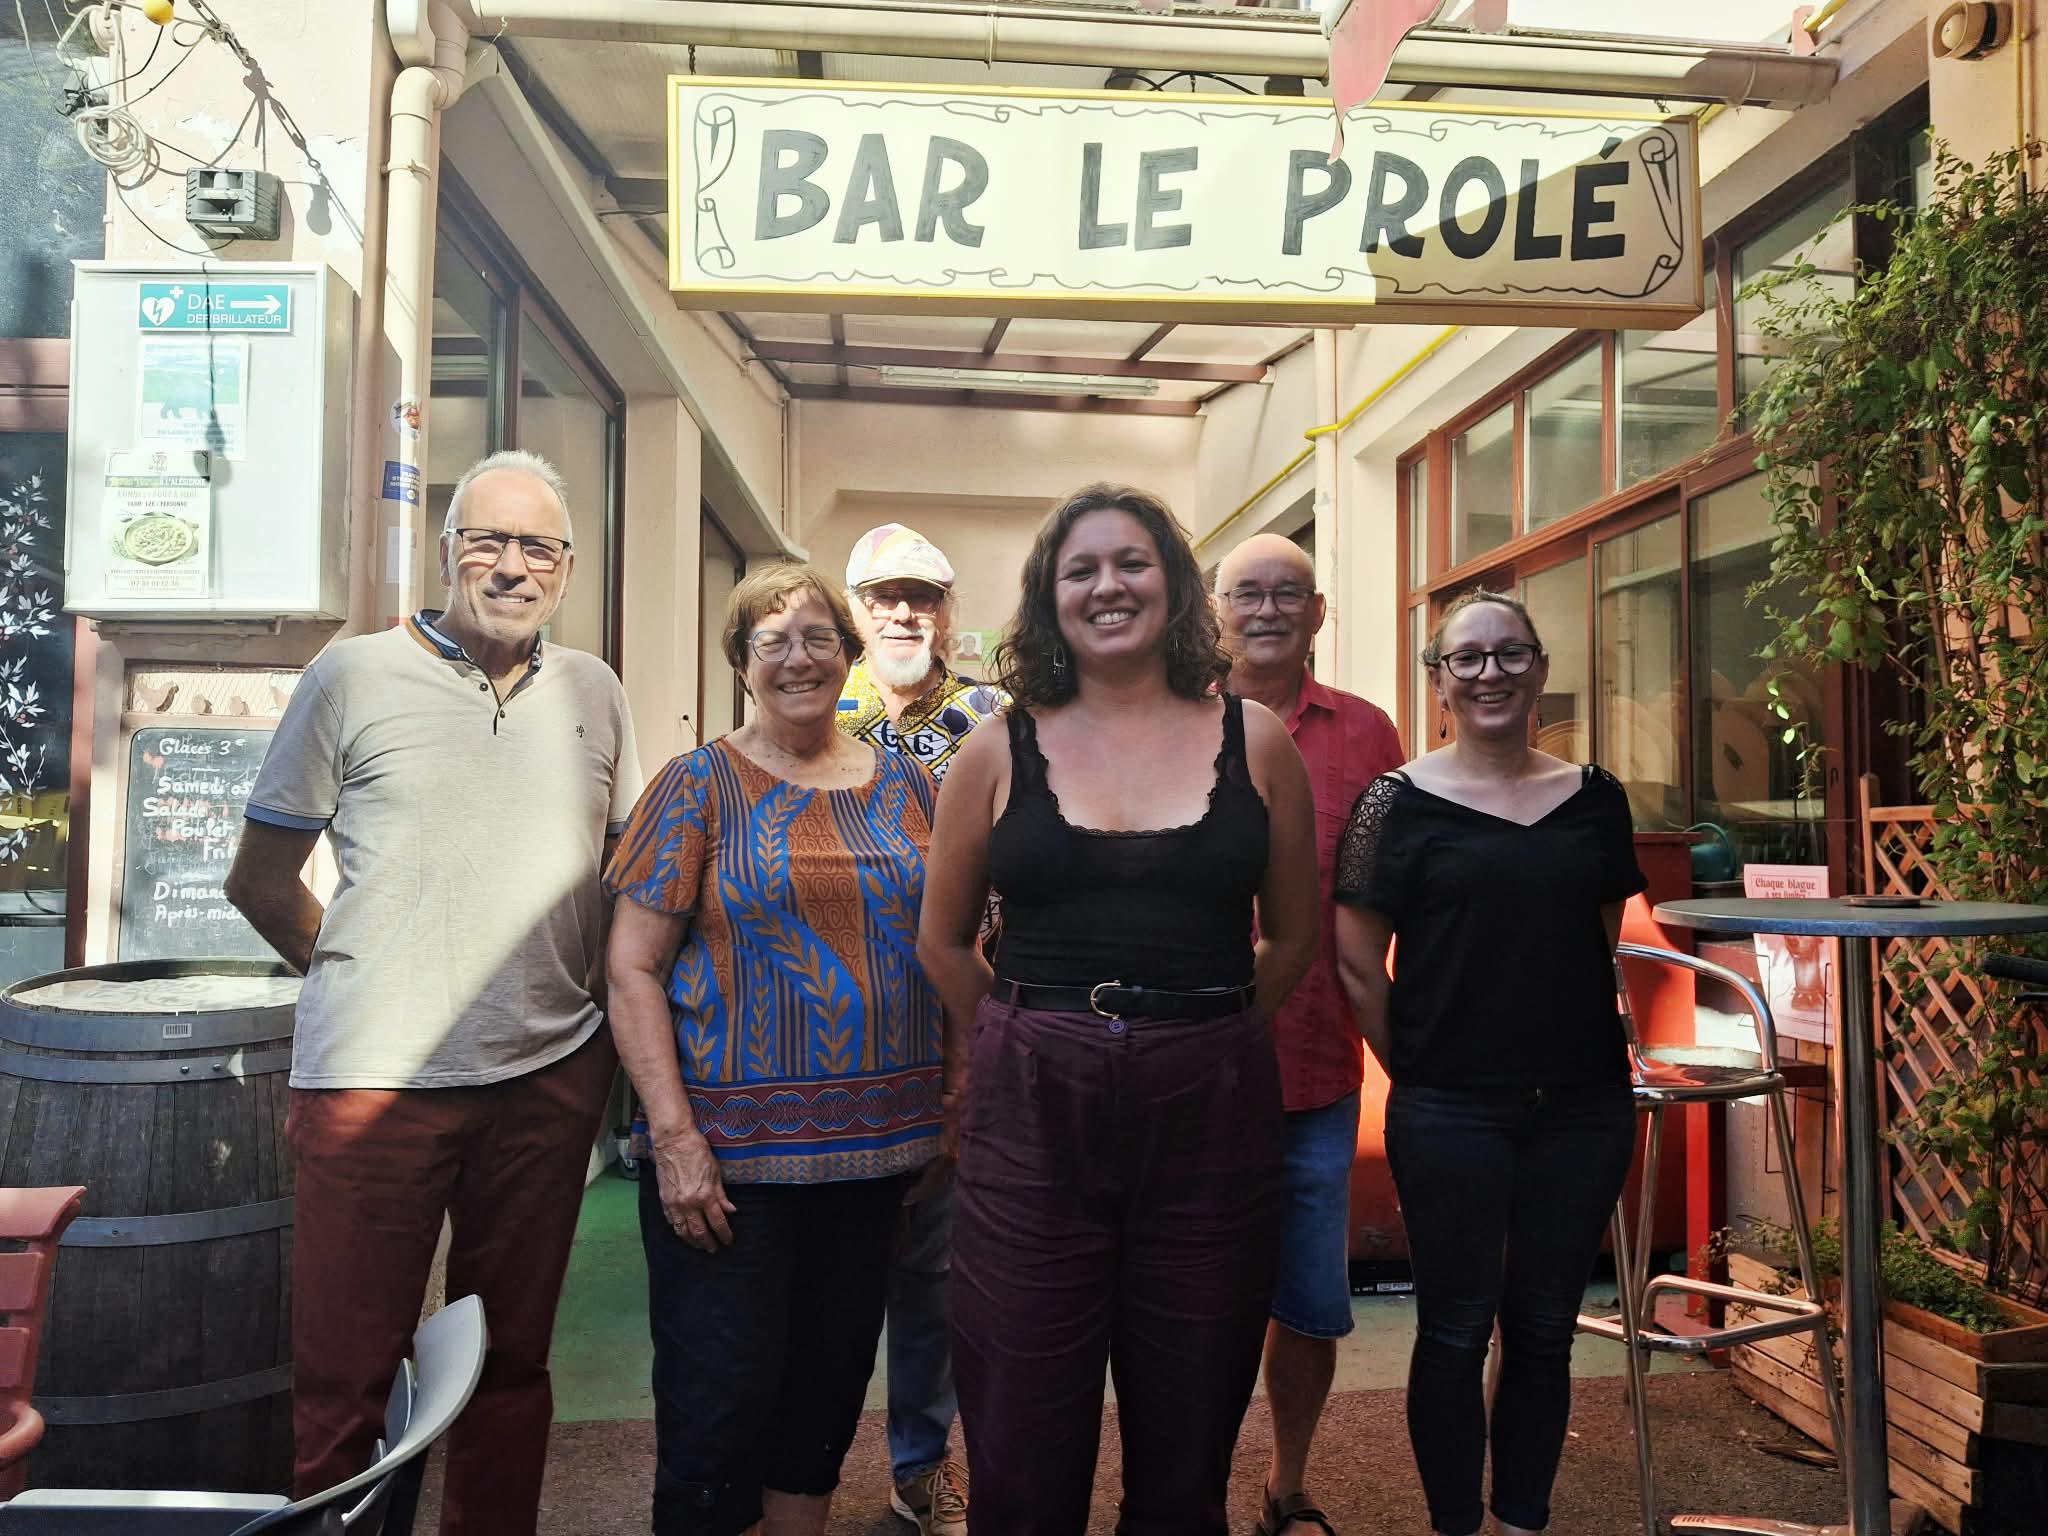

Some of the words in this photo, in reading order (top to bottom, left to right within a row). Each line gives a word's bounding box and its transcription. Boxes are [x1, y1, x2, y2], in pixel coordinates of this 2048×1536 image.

[755, 129, 990, 249] BAR
[1077, 142, 1199, 252] LE
[1282, 136, 1632, 262] PROLÉ
[188, 294, 225, 310] DAE
[160, 738, 212, 755] Glaces
[157, 776, 226, 795] Samedi
[143, 797, 209, 817] Salade
[172, 818, 234, 838] Poulet
[203, 836, 239, 863] Frit
[154, 881, 227, 900] Dimanc
[1755, 878, 1785, 890] Chaque
[1787, 878, 1816, 892] blague
